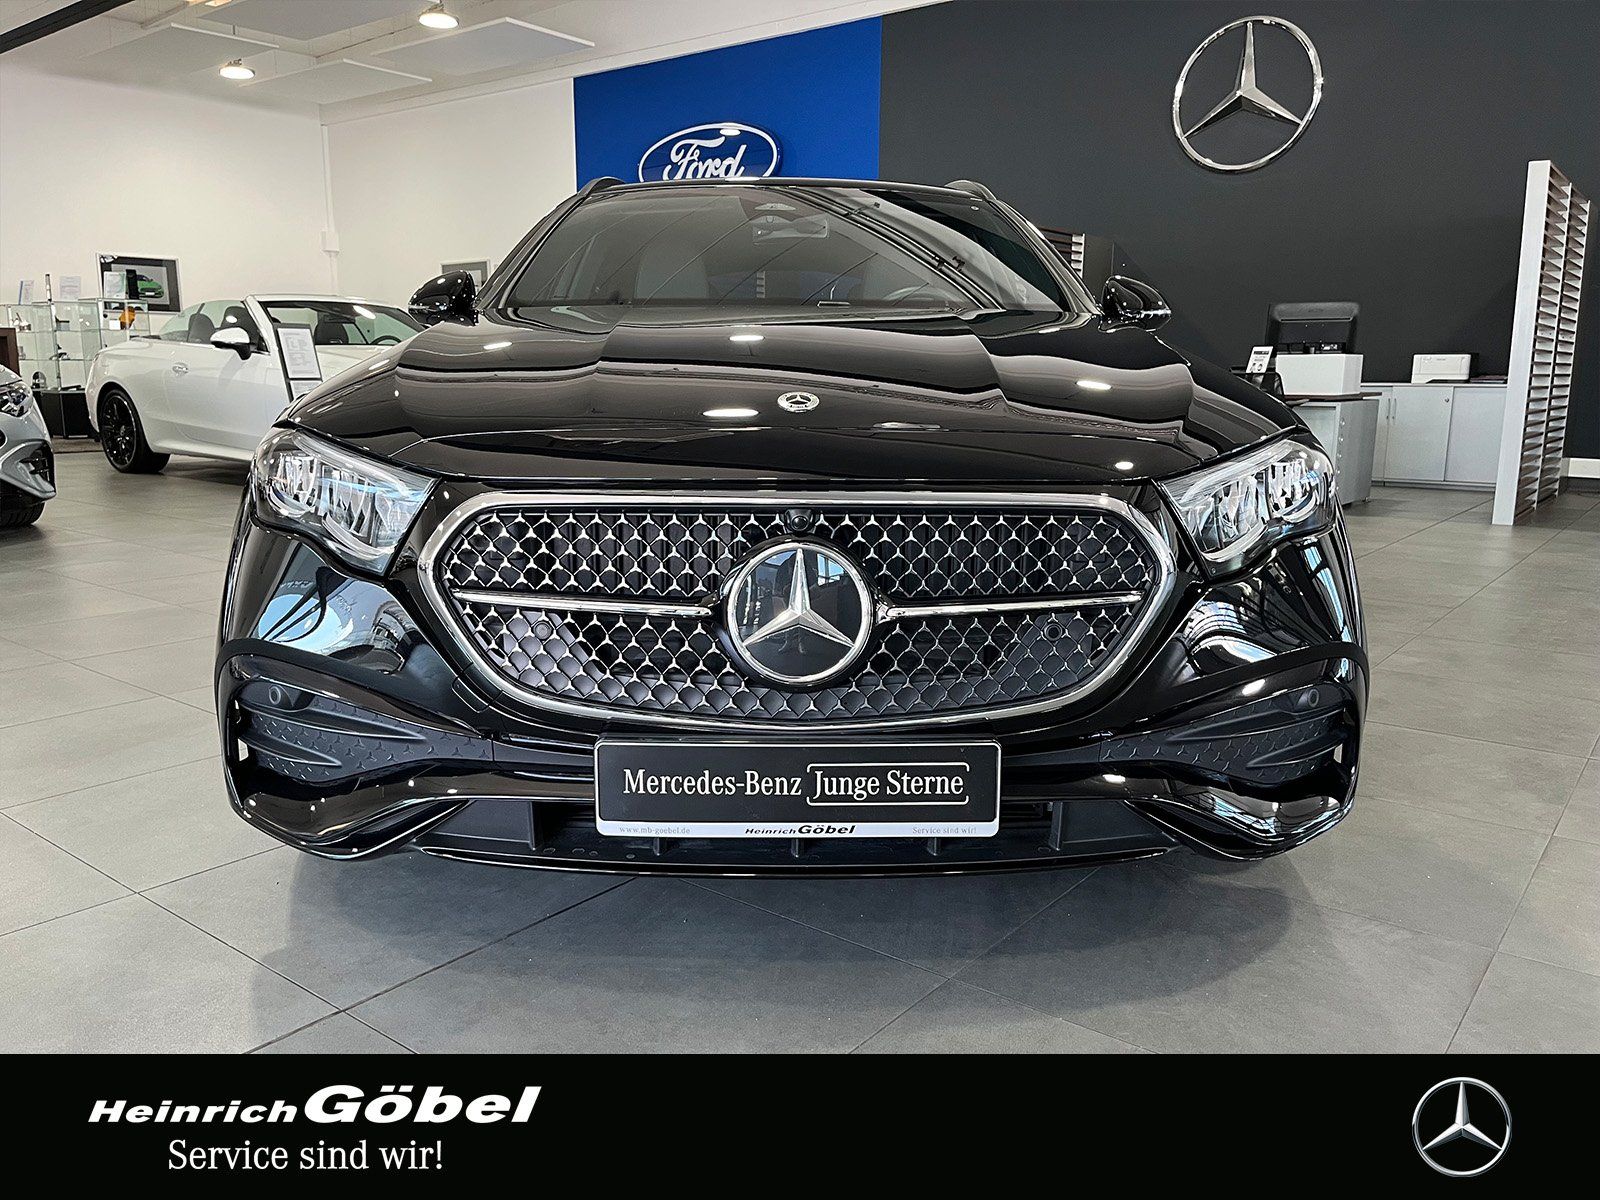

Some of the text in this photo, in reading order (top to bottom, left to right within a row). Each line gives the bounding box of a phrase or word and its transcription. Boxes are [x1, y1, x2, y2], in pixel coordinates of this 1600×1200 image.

[662, 136, 748, 180] Ford
[622, 768, 964, 801] Mercedes-Benz Junge Sterne
[618, 826, 691, 836] www.mb-goebel.de
[797, 824, 856, 835] Göbel
[912, 826, 942, 835] Service
[943, 826, 960, 835] sind
